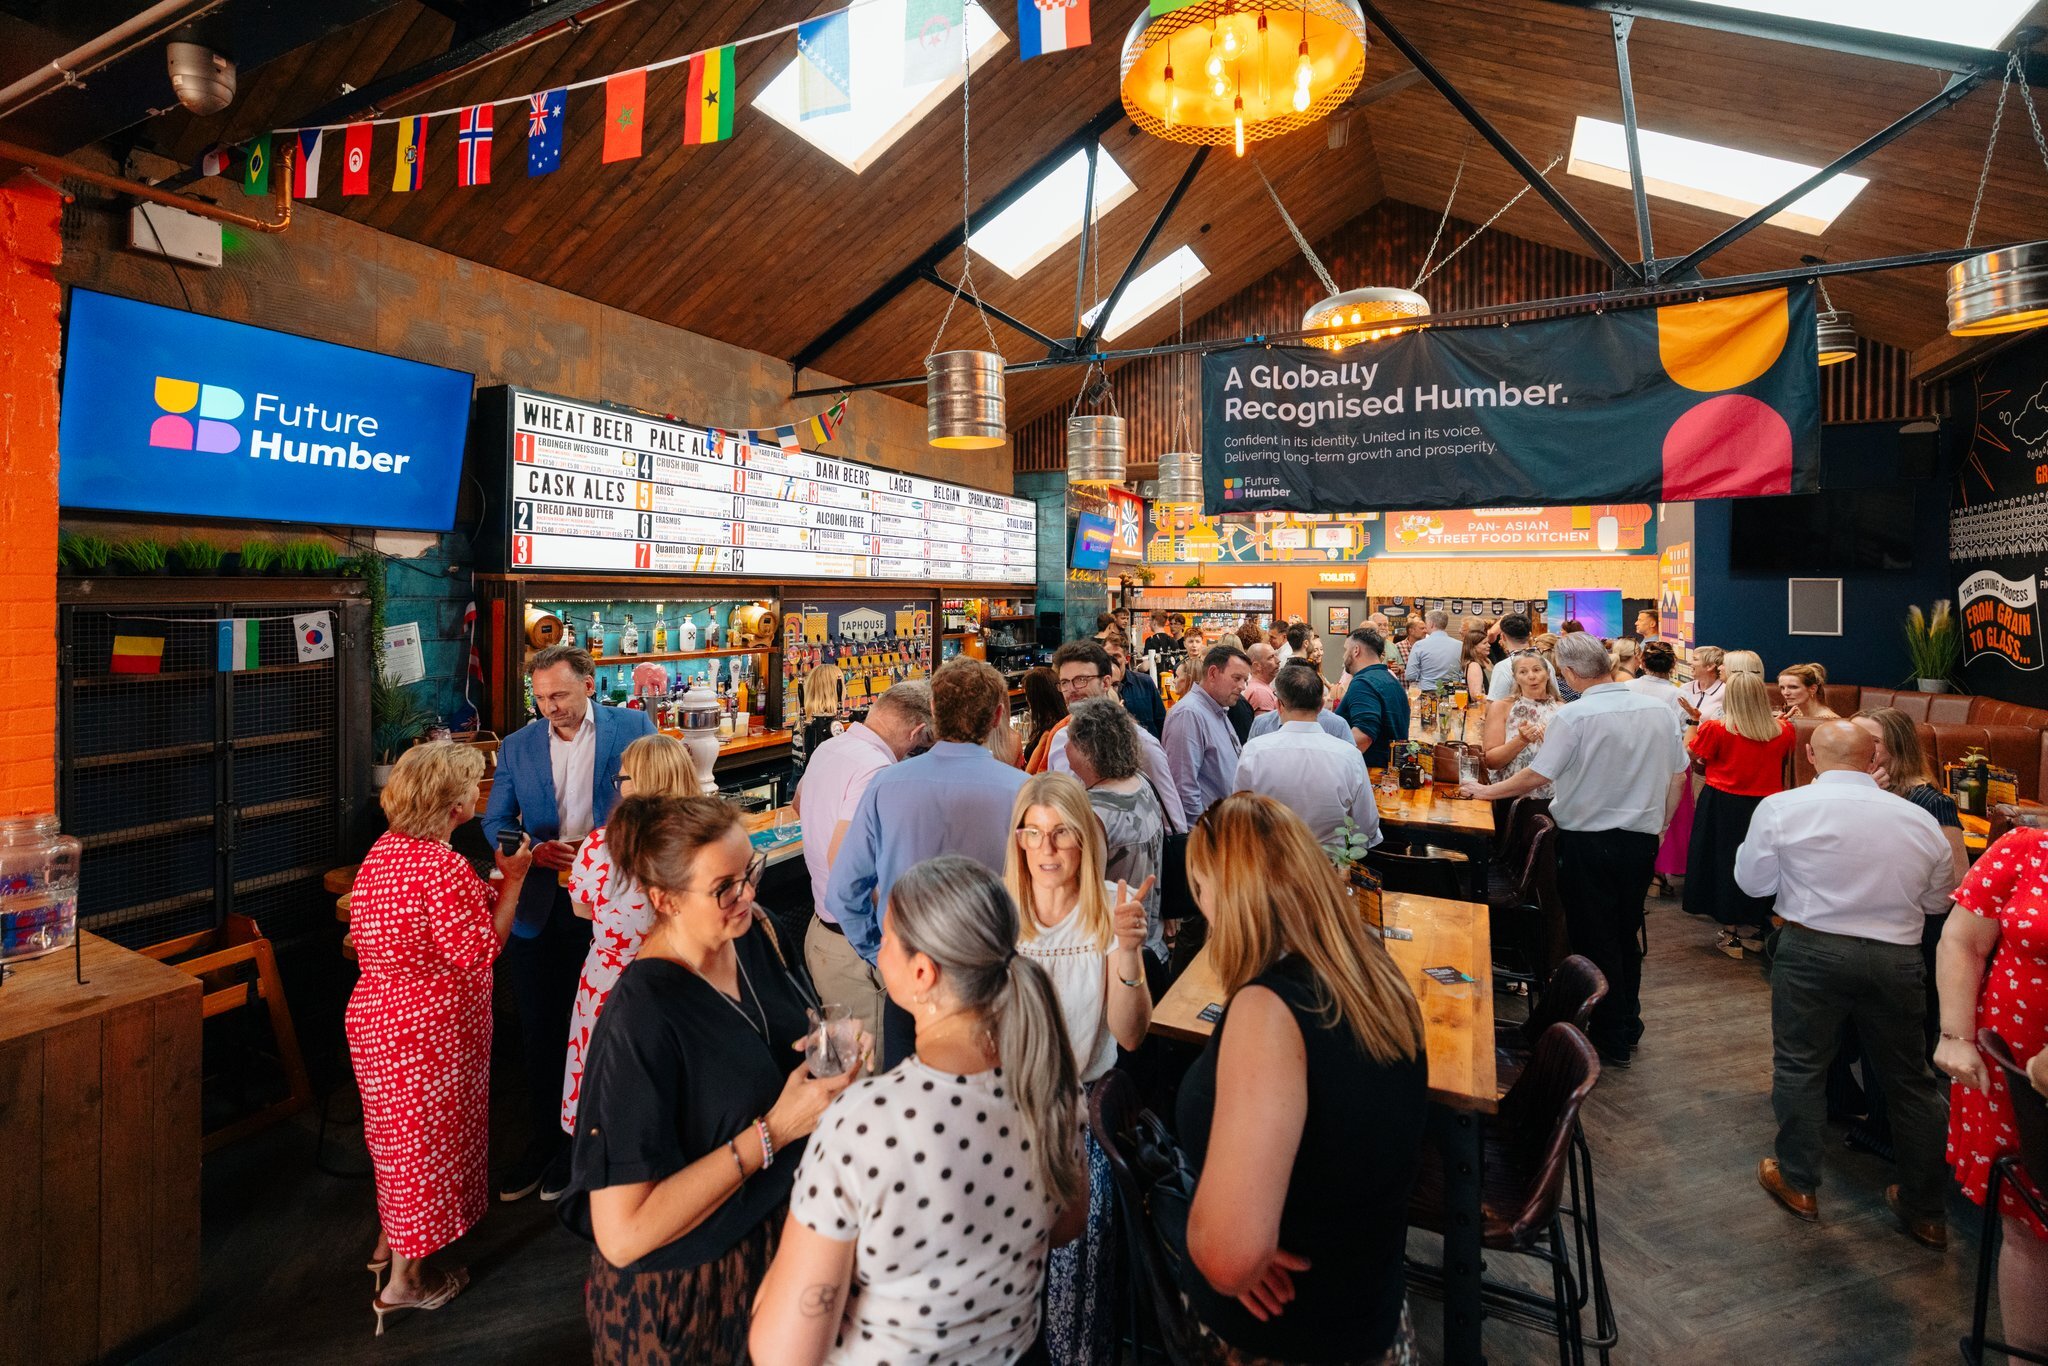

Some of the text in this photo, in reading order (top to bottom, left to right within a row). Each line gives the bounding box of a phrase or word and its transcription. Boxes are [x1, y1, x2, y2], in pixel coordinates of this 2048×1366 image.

[1224, 362, 1379, 391] A Globally
[254, 393, 379, 437] Future
[1225, 380, 1568, 428] Recognised Humber.
[523, 402, 585, 434] WHEAT
[593, 416, 633, 443] BEER
[650, 428, 686, 453] PALE
[1224, 425, 1483, 448] Confident in its identity. United in its voice.
[250, 429, 410, 474] Humber
[521, 434, 528, 462] 1
[538, 437, 572, 451] ERDINGER
[573, 443, 609, 457] WEISSBIER
[1225, 440, 1498, 466] Delivering long-term growth and prosperity.
[641, 455, 650, 479] 4
[656, 456, 680, 470] CRUSH
[681, 461, 699, 473] HOUR
[748, 471, 762, 481] FAITH
[529, 471, 625, 503] CASK ALES
[816, 461, 840, 481] DARK
[843, 467, 870, 486] BEERS
[889, 476, 913, 494] LAGER
[1244, 476, 1280, 487] Future
[640, 482, 649, 509] 5
[655, 485, 675, 496] ARISE
[1245, 487, 1291, 498] Humber
[518, 502, 529, 530] 2
[536, 503, 614, 520] BREAD AND BUTTER
[734, 497, 744, 519] 10
[816, 511, 848, 527] ALCOHOL
[849, 515, 864, 529] FREE
[641, 514, 649, 538] 6
[655, 516, 681, 525] ERASMUS
[1468, 521, 1549, 532] PAN- ASIAN
[517, 536, 528, 564] 3
[655, 544, 686, 554] Quantom
[687, 545, 703, 556] State
[1428, 532, 1589, 544] STREET FOOD KITCHEN
[639, 544, 647, 568] 7
[734, 549, 743, 571] 12
[1319, 572, 1356, 582] TOILETS
[1962, 578, 2029, 602] THE BREWING PROCESS
[842, 620, 884, 630] TAPHOUSE
[1966, 601, 2031, 636] FROM GRAIN
[1969, 626, 2031, 664] TO GLASS...
